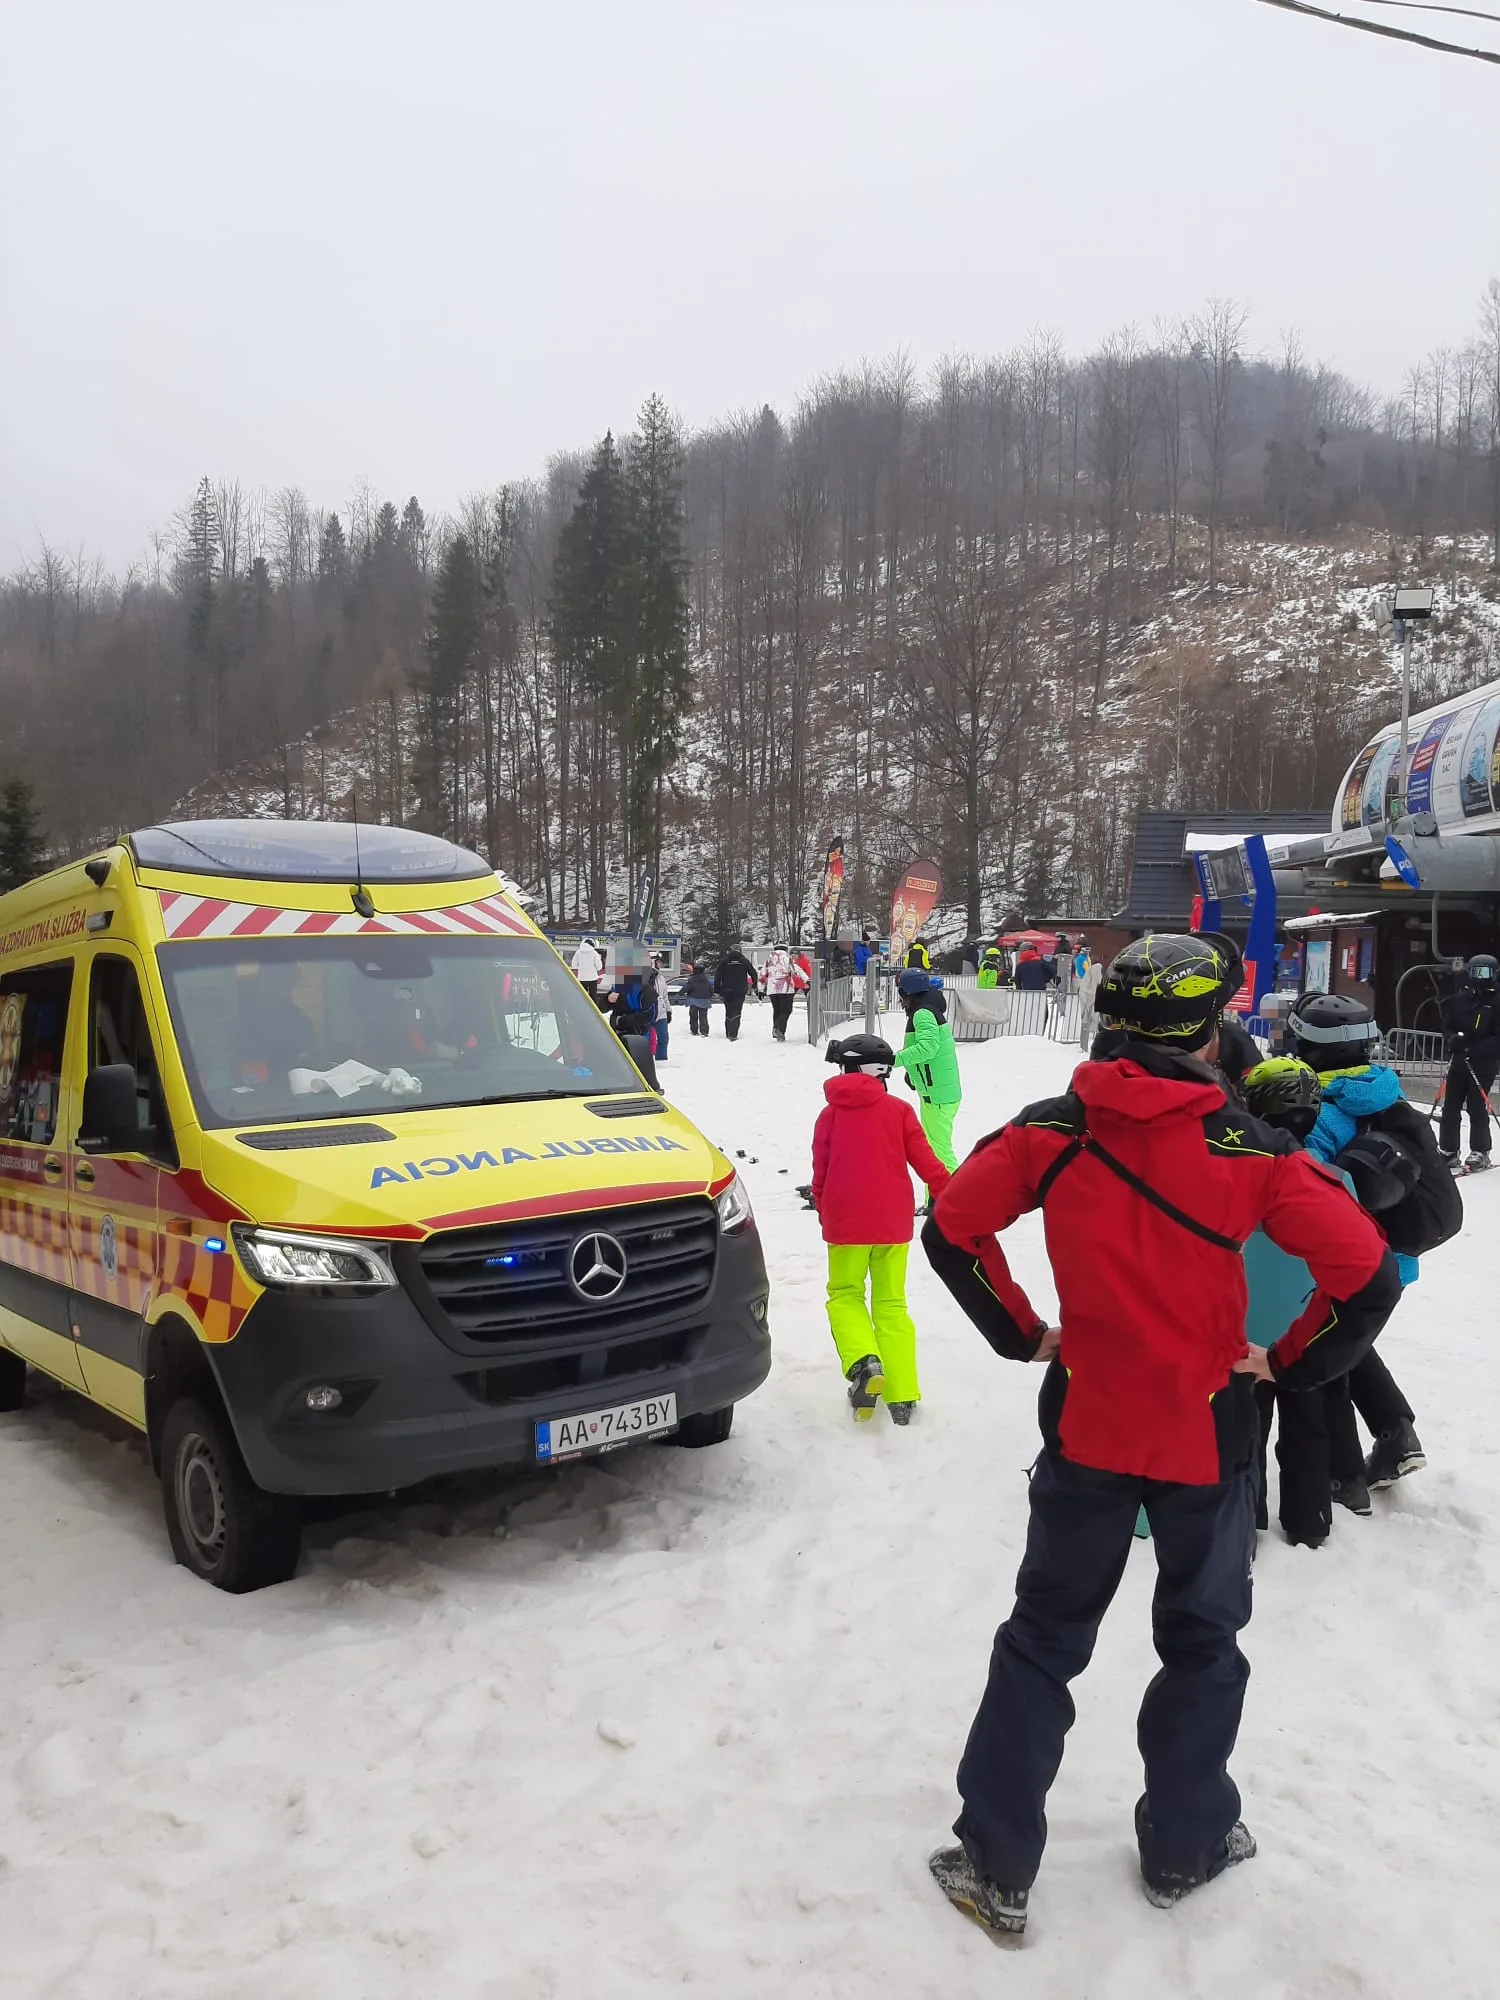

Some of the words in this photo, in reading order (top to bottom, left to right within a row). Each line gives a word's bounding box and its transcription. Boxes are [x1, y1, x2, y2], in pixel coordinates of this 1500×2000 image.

[51, 906, 87, 940] SLUŽBA
[1165, 967, 1193, 983] CAMP
[538, 1442, 550, 1452] SK
